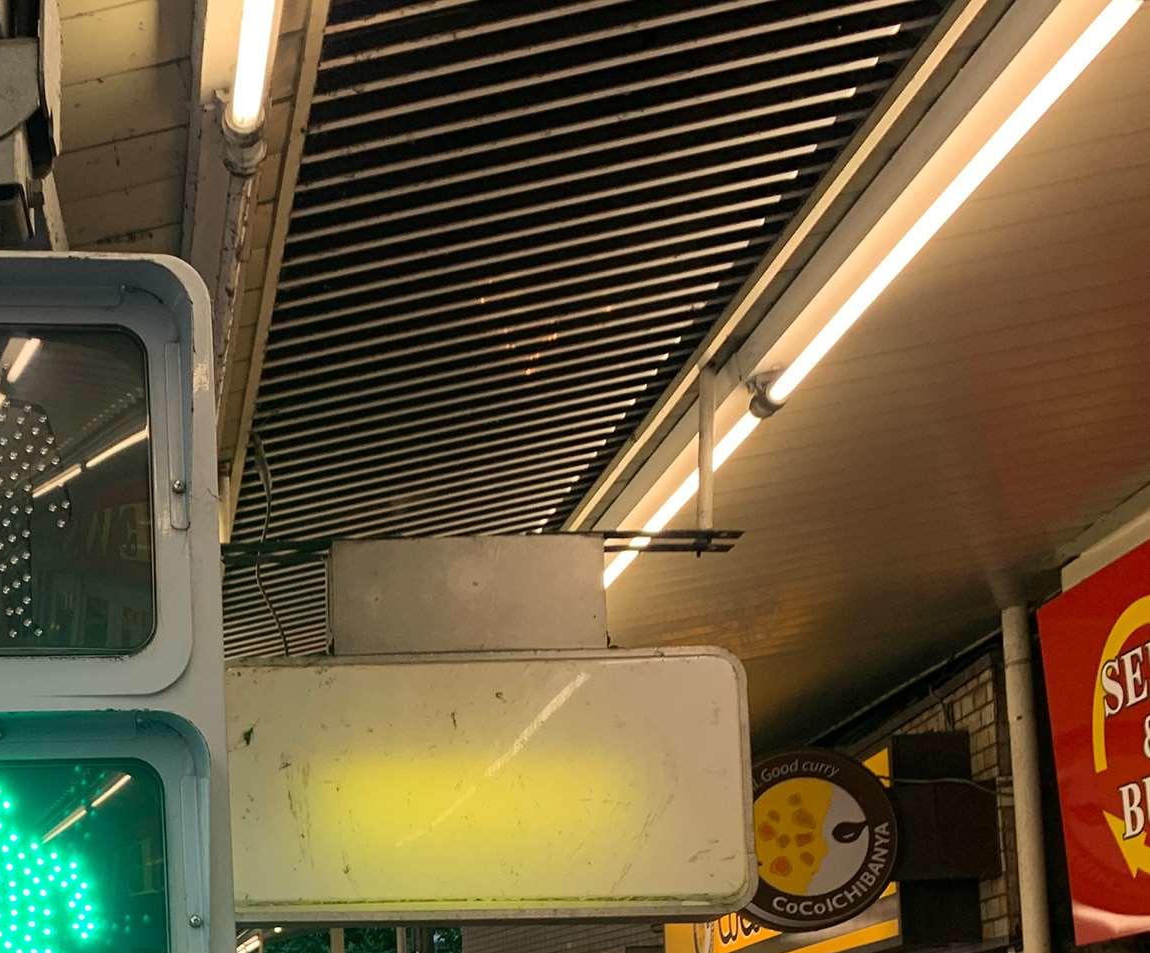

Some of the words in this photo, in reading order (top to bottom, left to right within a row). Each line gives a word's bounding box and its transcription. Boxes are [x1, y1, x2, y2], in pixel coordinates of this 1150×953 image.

[1101, 641, 1150, 718] SE
[761, 759, 799, 782] Good
[802, 760, 840, 778] curry
[1118, 776, 1150, 839] B
[772, 822, 891, 916] CoCoICHIBANYA
